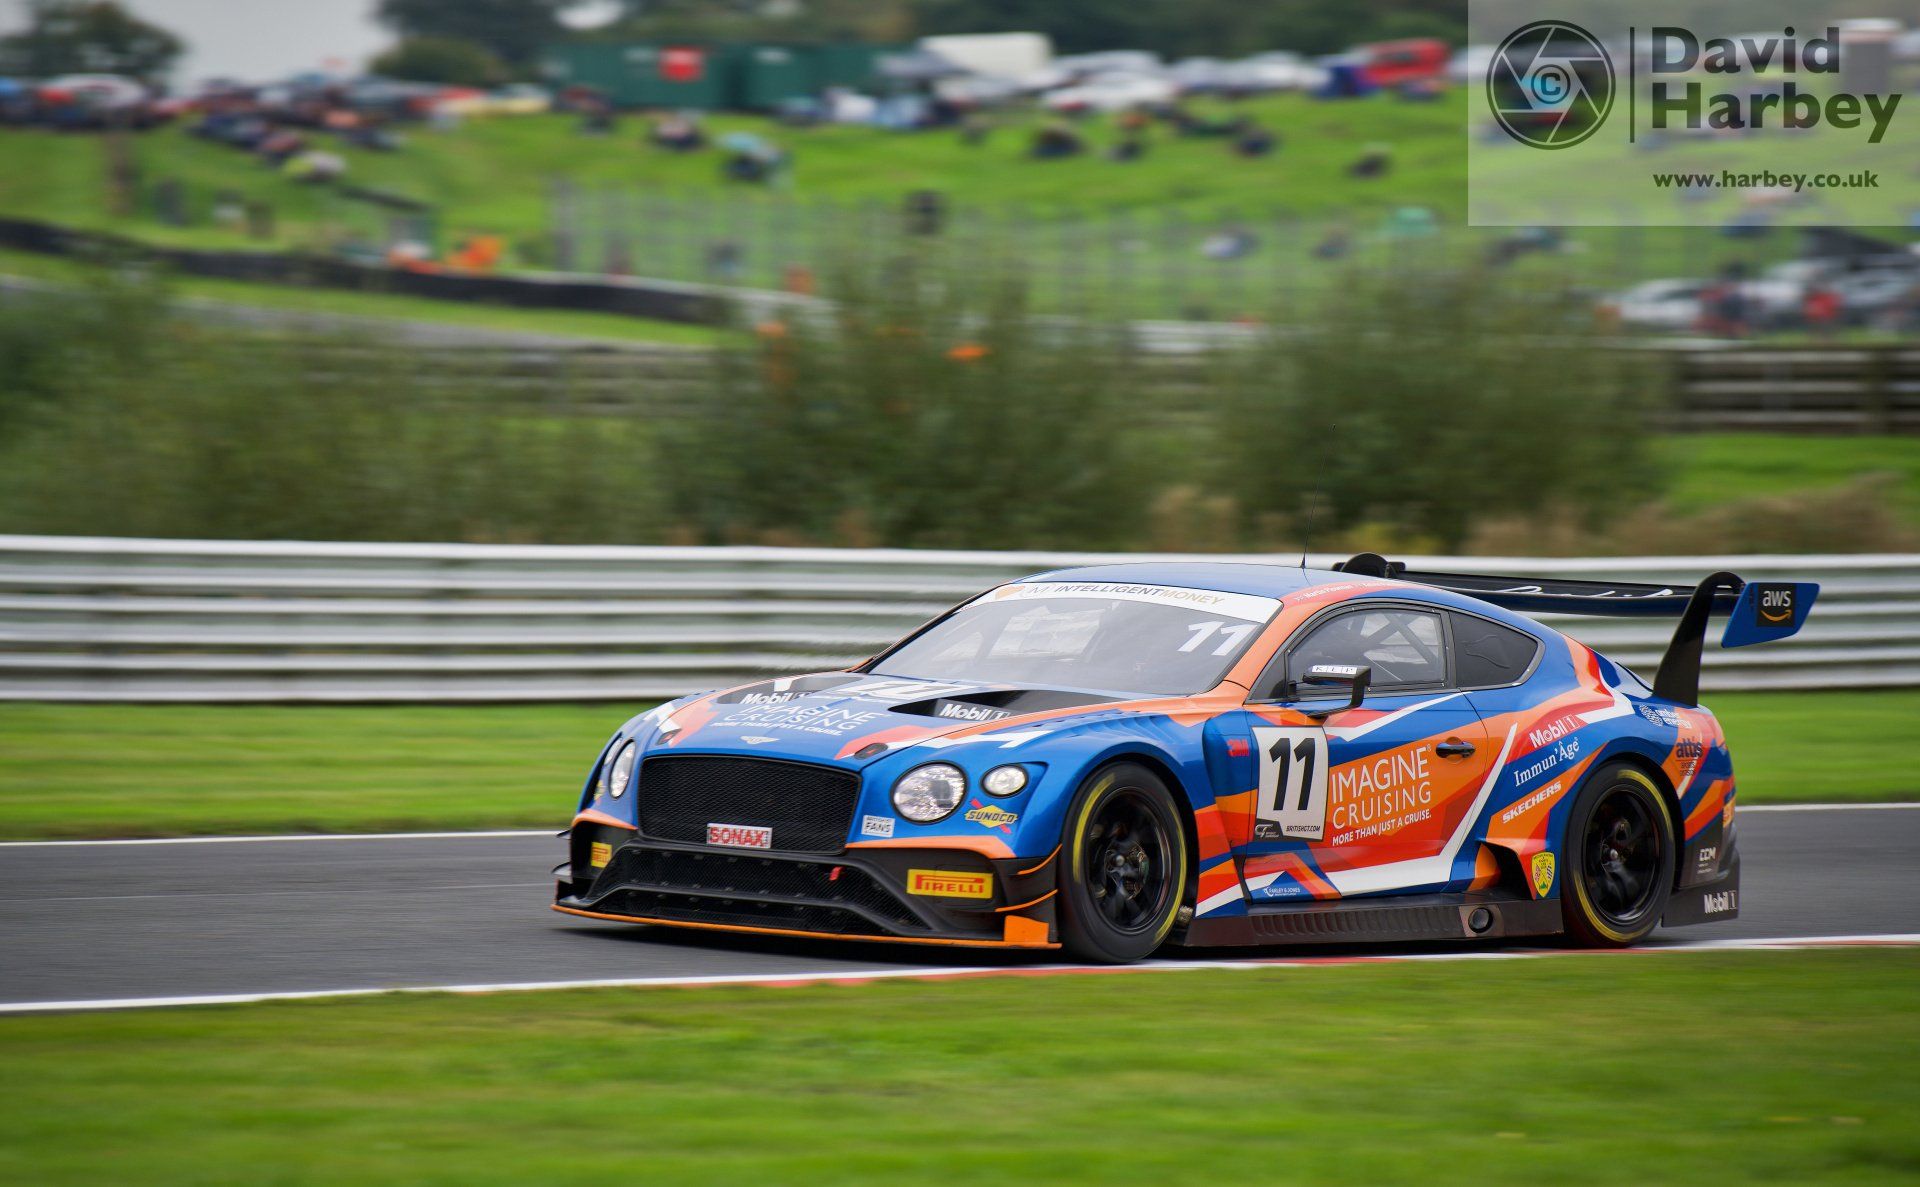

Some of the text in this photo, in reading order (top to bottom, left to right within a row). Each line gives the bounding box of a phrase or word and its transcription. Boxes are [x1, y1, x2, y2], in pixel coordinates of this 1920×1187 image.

[1762, 590, 1792, 607] aws
[1177, 621, 1261, 656] 11
[739, 692, 794, 705] Mobil
[723, 713, 863, 730] CRUISING
[739, 704, 885, 723] IMAGINE
[939, 703, 993, 721] Mobil
[1529, 719, 1569, 749] Mobil
[1269, 737, 1315, 811] 11
[1332, 747, 1430, 804] IMAGINE
[1333, 781, 1431, 829] CRUISING
[1502, 780, 1562, 824] SKECHERS
[967, 810, 1015, 824] SUNOCO
[1332, 808, 1432, 846] MORE THAN JUST A CRUISE.
[709, 826, 763, 848] SONAX
[915, 873, 984, 894] PIRELLI
[1704, 891, 1729, 914] Mobil
